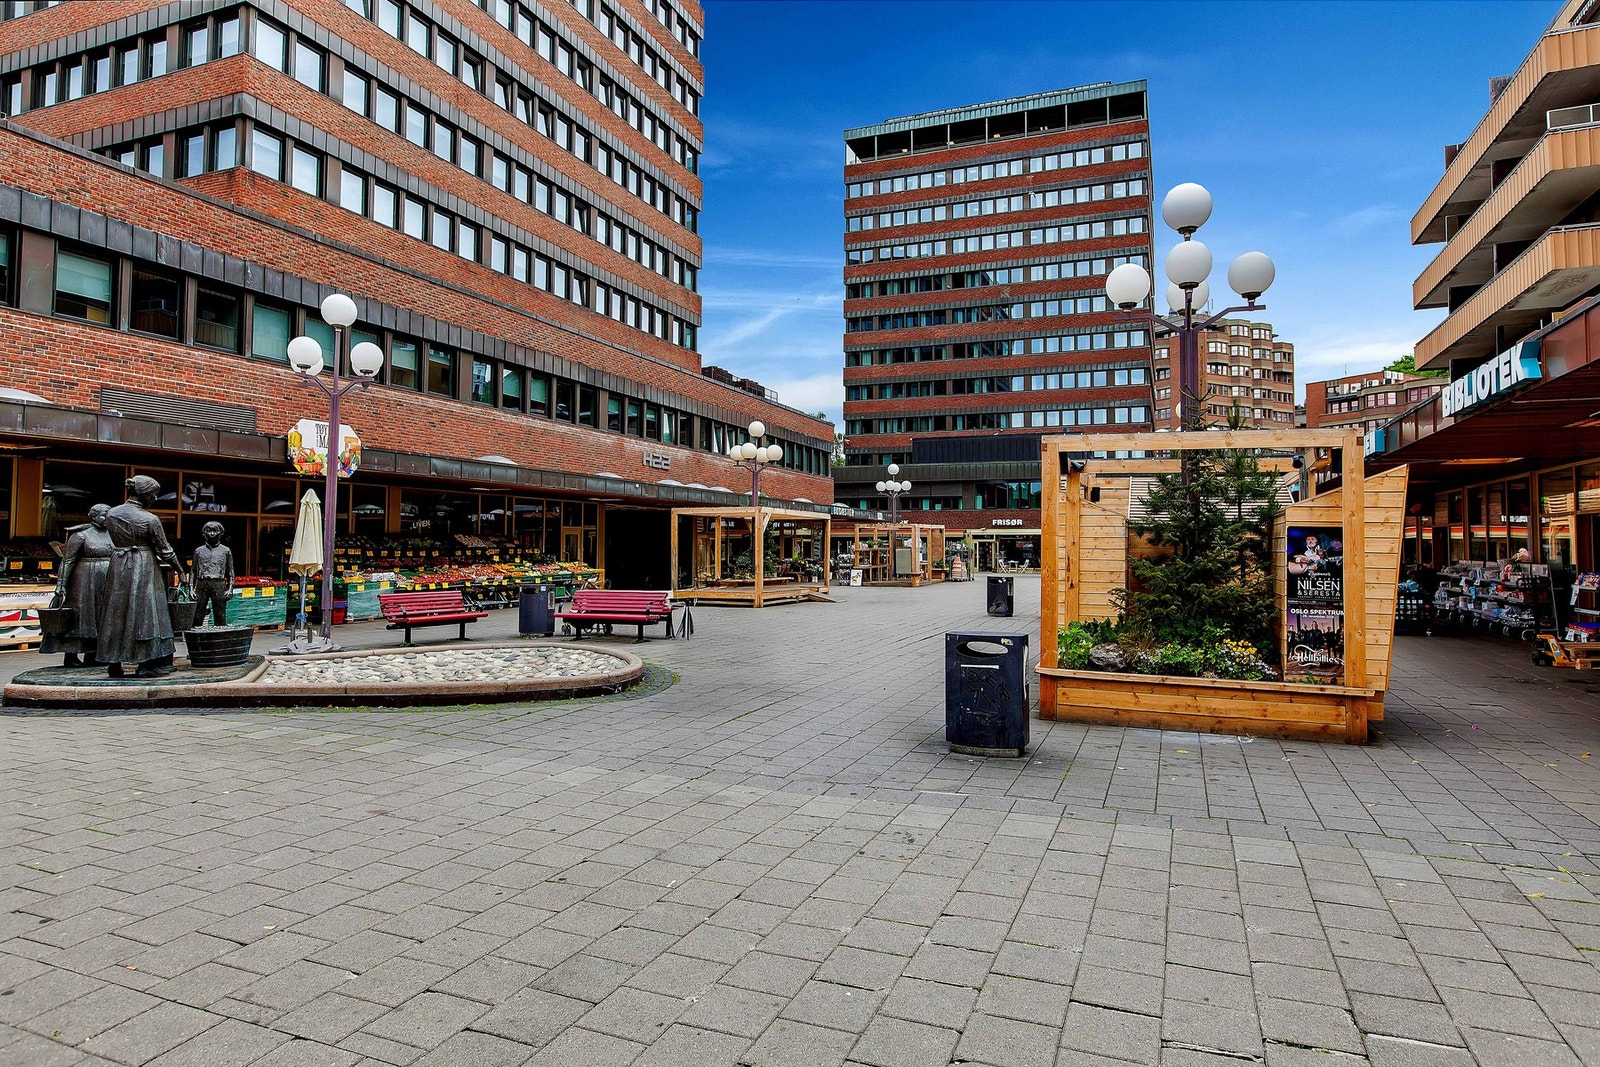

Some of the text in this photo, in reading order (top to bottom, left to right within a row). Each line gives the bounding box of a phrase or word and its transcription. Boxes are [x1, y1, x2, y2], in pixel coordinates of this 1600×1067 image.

[1442, 341, 1530, 418] BIBLIOTEK
[642, 451, 671, 470] H22
[1297, 580, 1340, 591] NILSEN
[1291, 645, 1345, 666] Hellbillies
